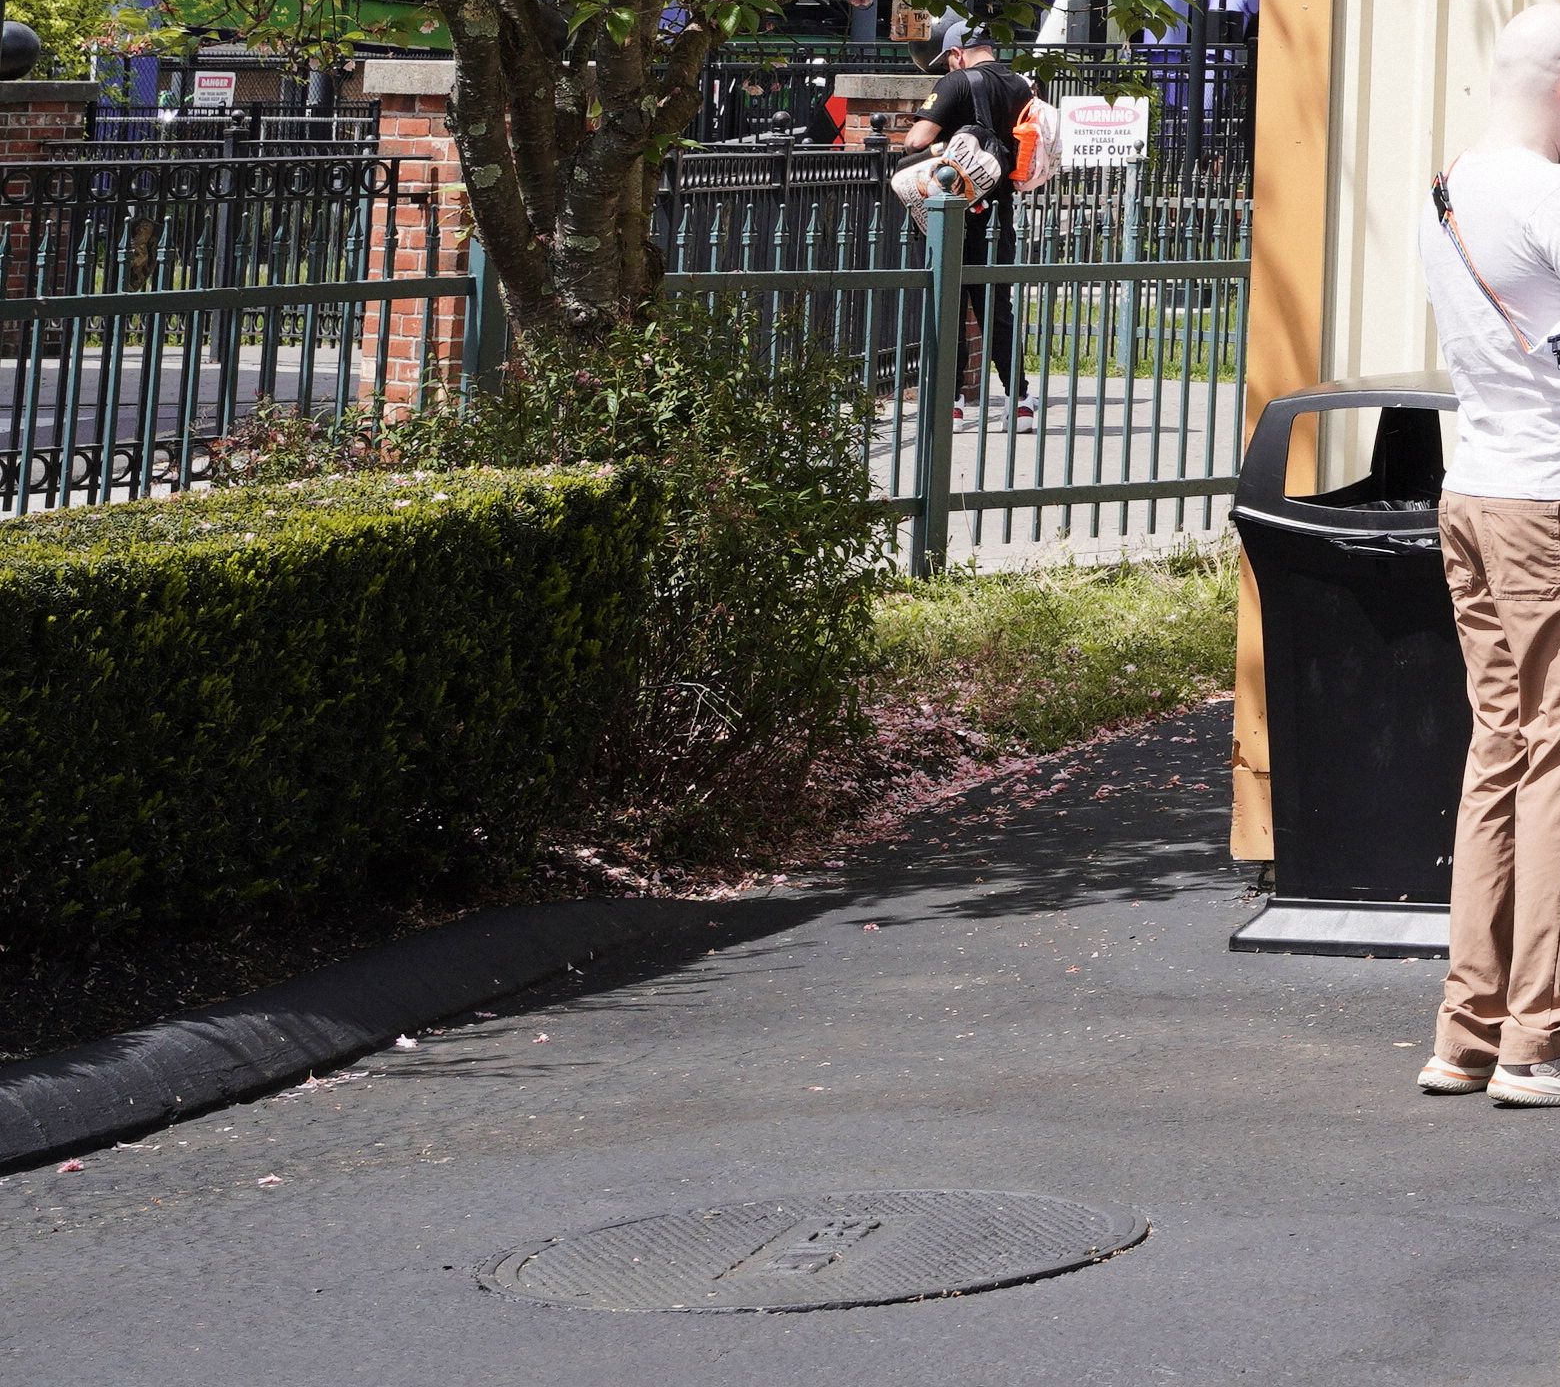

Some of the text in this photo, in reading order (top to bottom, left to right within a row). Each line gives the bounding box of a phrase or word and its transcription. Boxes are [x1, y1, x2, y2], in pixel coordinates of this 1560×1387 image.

[201, 78, 229, 87] DANGER
[1074, 109, 1135, 123] WARNING
[1073, 145, 1133, 155] KEEP OUT
